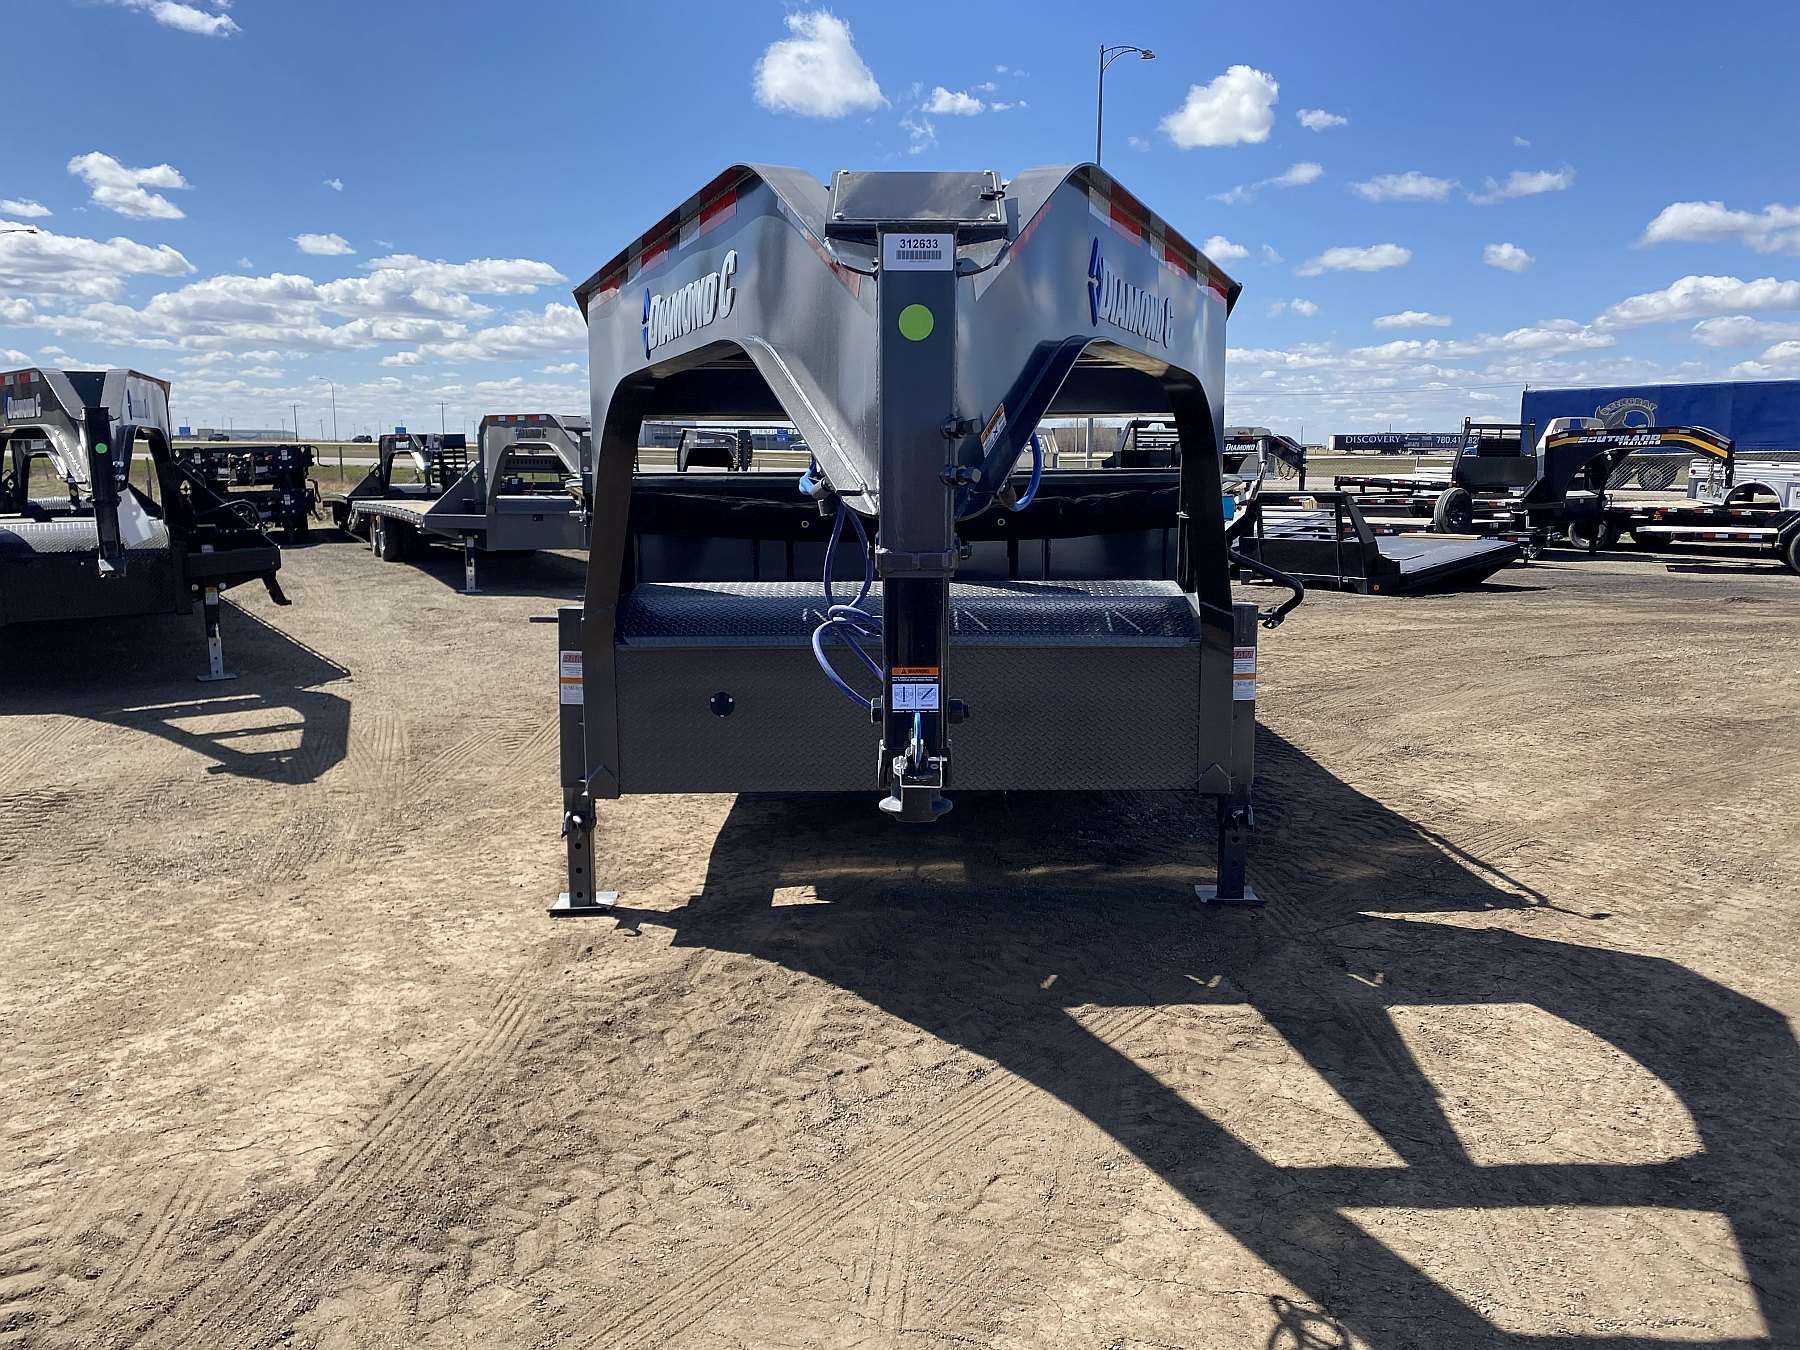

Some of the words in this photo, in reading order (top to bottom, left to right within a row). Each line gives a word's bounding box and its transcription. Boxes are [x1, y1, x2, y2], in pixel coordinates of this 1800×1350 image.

[900, 239, 938, 249] 312633
[648, 271, 720, 350] DIAMOND
[719, 249, 737, 319] C
[1099, 262, 1162, 344] DIAMOND
[1345, 435, 1400, 444] DISCOVERY
[1578, 434, 1660, 443] SOUTHLAND
[1225, 443, 1255, 451] DIAMOND
